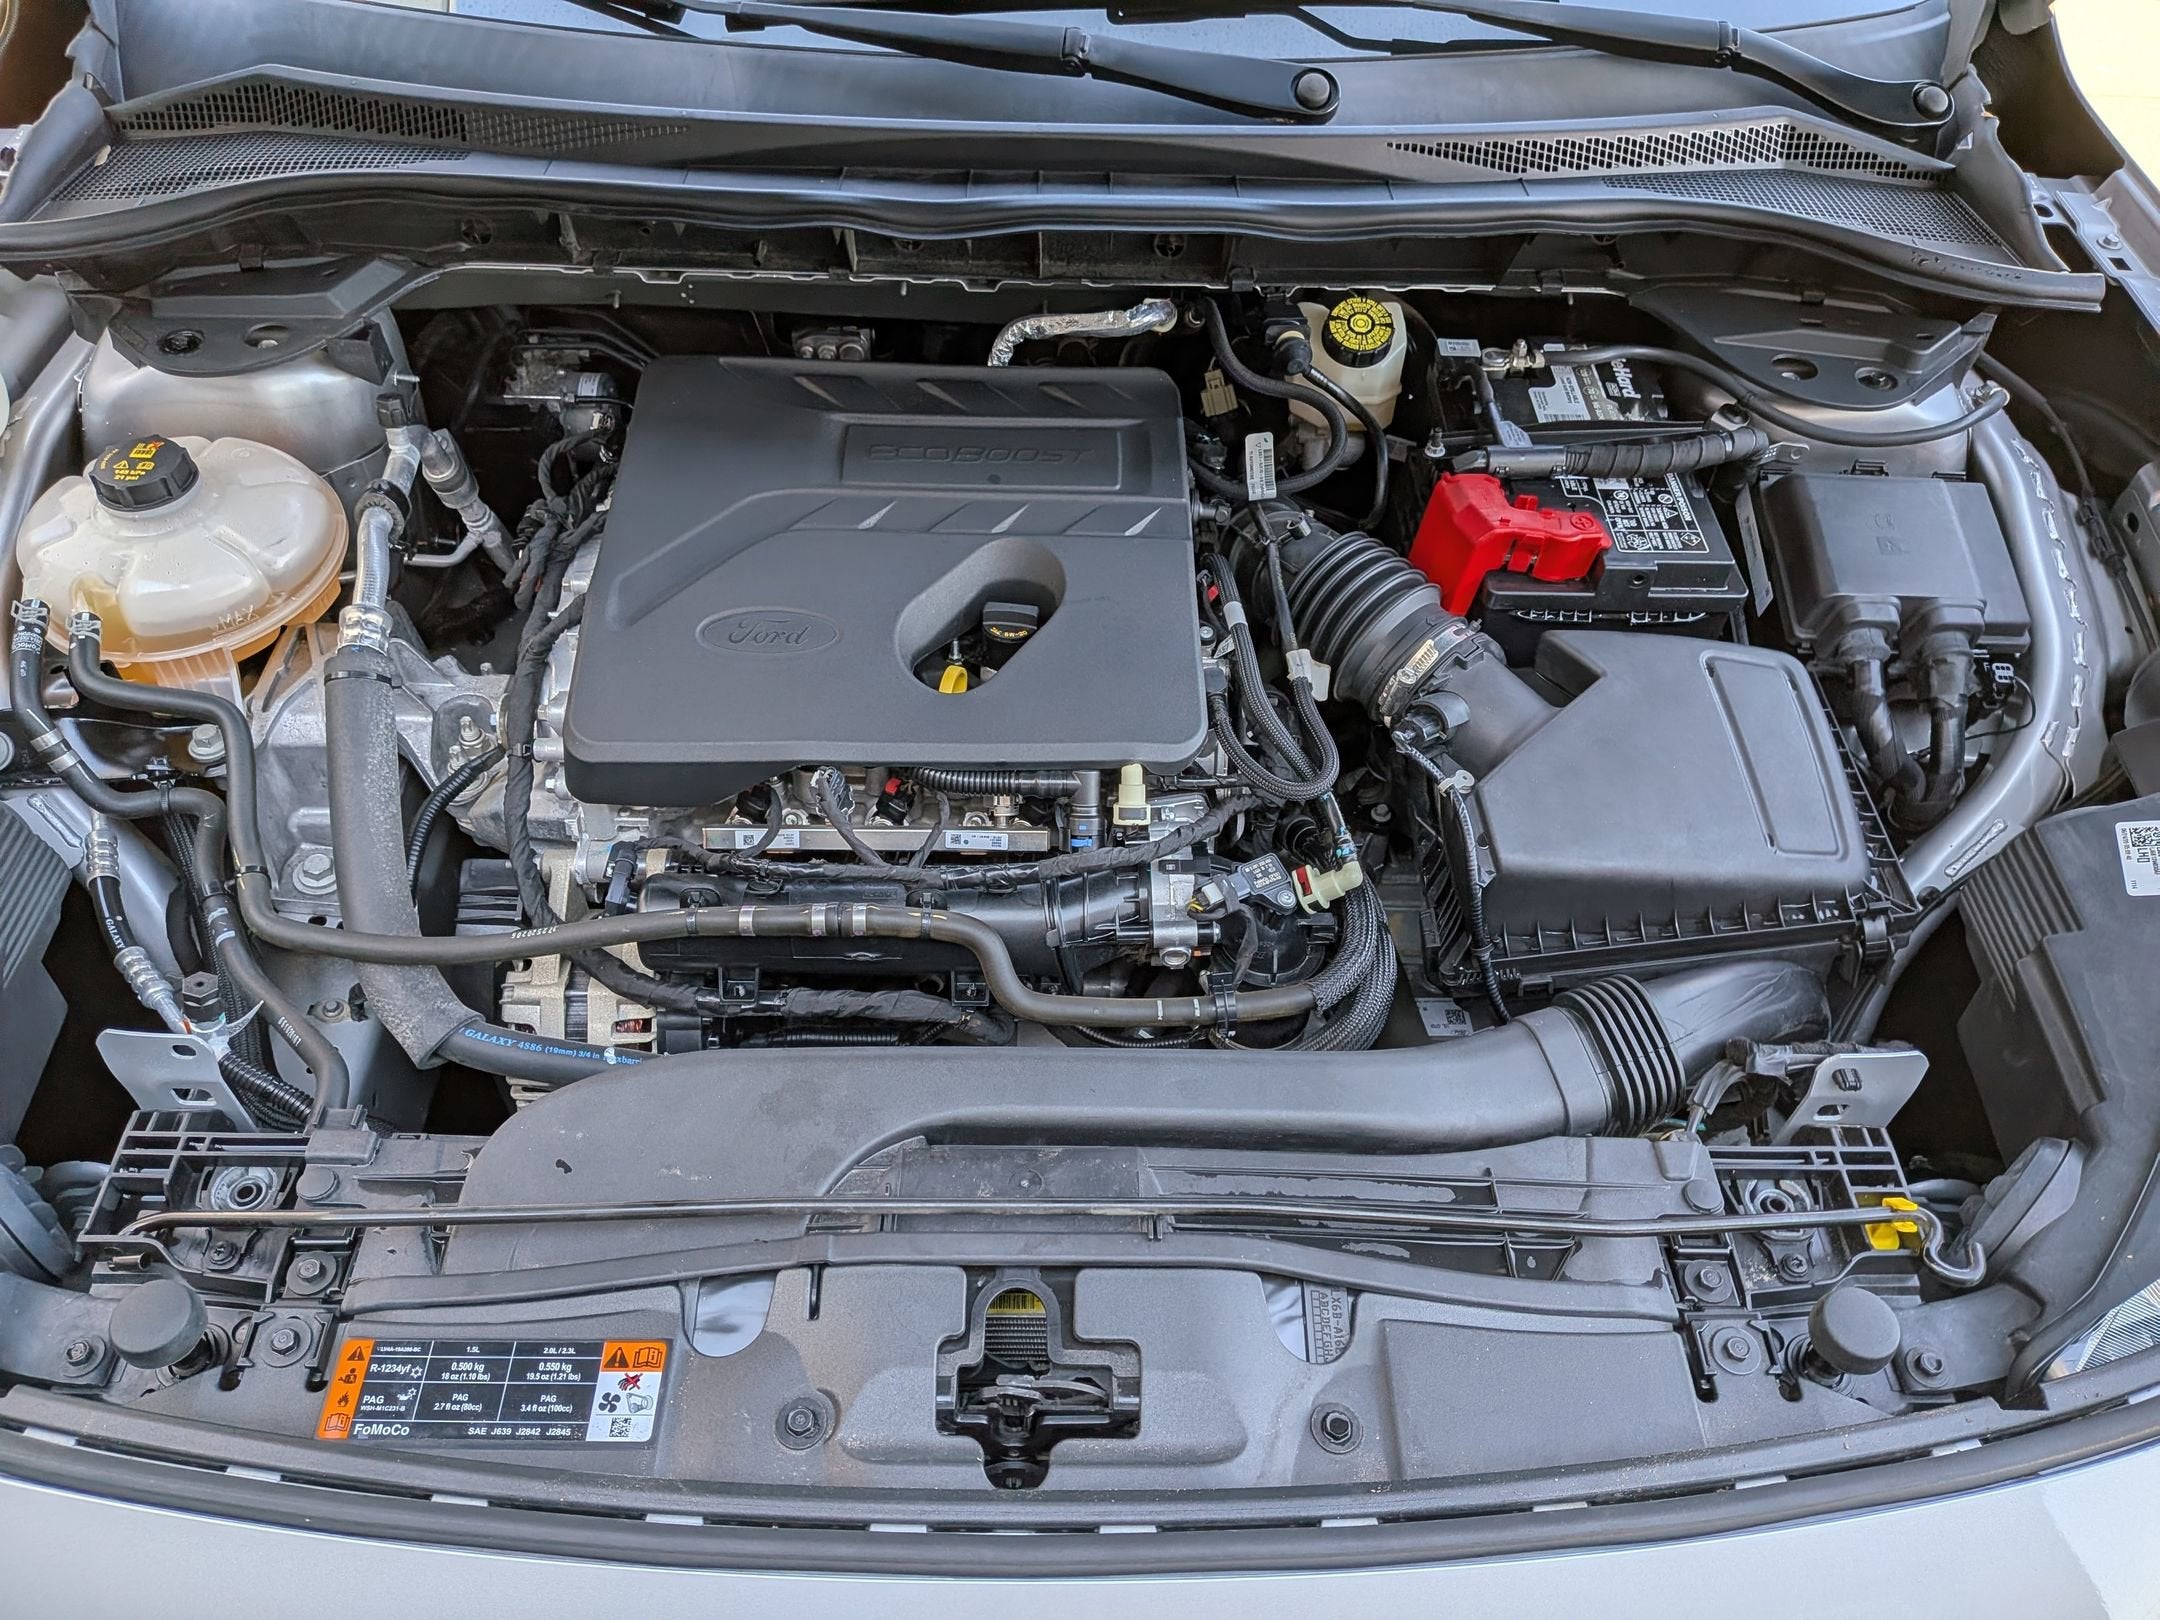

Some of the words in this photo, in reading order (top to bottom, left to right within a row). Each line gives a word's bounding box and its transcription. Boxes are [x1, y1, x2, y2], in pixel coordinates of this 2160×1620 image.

[728, 618, 811, 645] Ford
[105, 917, 126, 950] GALAXY
[465, 1028, 518, 1048] GALAXY
[517, 1041, 542, 1053] 4886
[544, 1045, 577, 1058] (19mm)
[578, 1050, 591, 1059] 3/4
[1319, 1291, 1334, 1362] ABCDEFGH
[369, 1363, 411, 1374] R-1234yf
[451, 1362, 473, 1371] 0.500
[473, 1362, 485, 1372] kg
[538, 1362, 561, 1371] 0.550
[561, 1362, 573, 1372] kg
[441, 1373, 450, 1381] 18
[459, 1373, 476, 1381] (1.10
[477, 1373, 491, 1382] lbs)
[550, 1373, 567, 1381] (1.21
[567, 1373, 581, 1382] lbs)
[362, 1395, 385, 1404] PAG
[451, 1393, 469, 1401] PAG
[540, 1394, 557, 1402] PAG
[433, 1403, 445, 1411] 2.7
[547, 1404, 573, 1414] (100cc)
[353, 1423, 410, 1436] FoMoCo
[467, 1427, 487, 1435] SAE
[491, 1427, 512, 1436] J639
[515, 1427, 541, 1436] J2842
[545, 1427, 572, 1436] J2845
